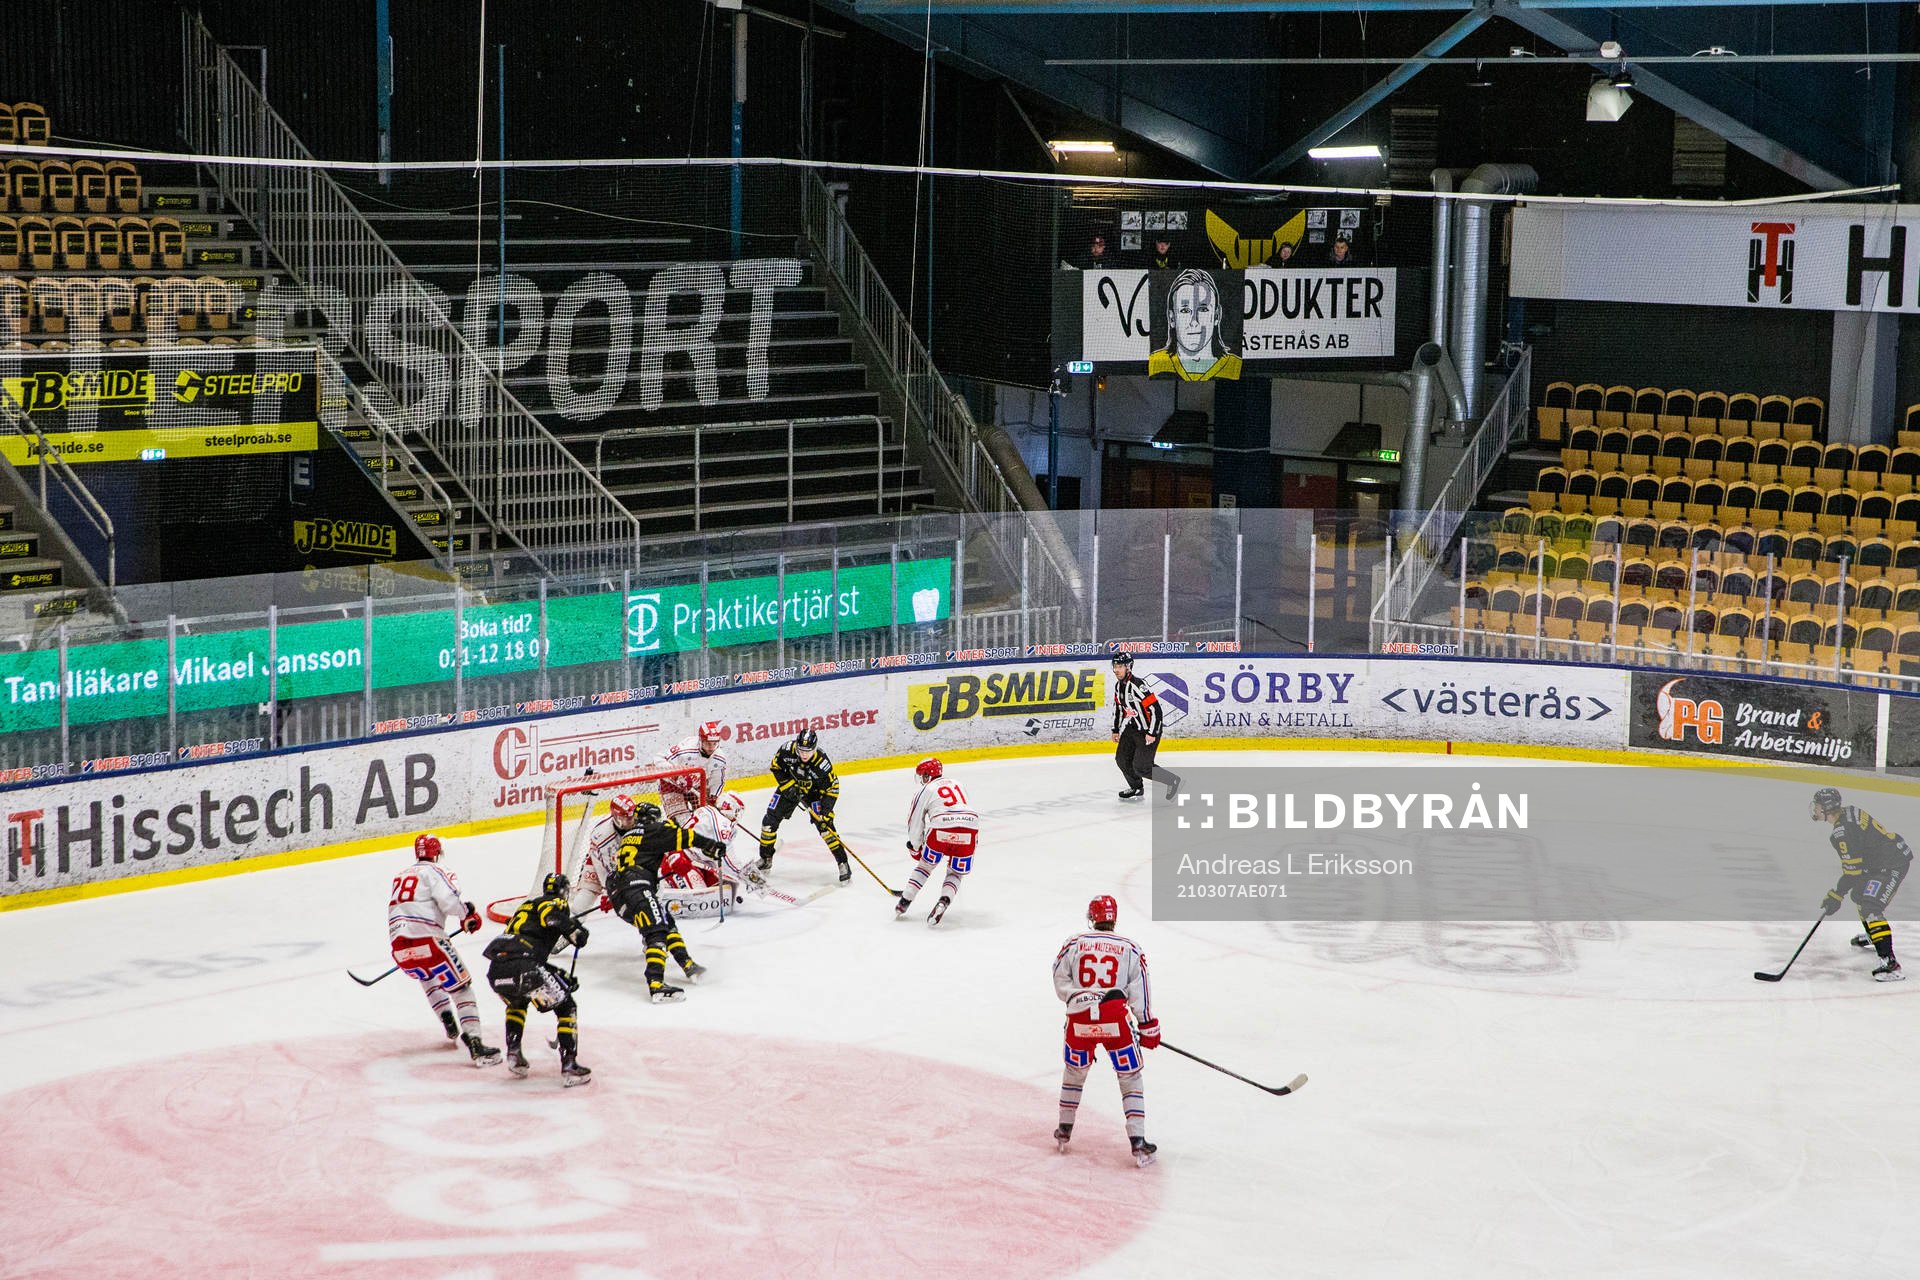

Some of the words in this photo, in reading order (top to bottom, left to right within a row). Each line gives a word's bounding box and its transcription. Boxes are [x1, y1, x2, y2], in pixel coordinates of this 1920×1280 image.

[1244, 277, 1384, 320] ODUKTER
[1242, 330, 1320, 350] STERÅS
[1325, 334, 1349, 349] AB
[204, 373, 302, 395] STEELPRO
[27, 442, 104, 458] jmide.se
[205, 431, 292, 448] steelproab.se
[460, 618, 498, 641] Boka
[501, 613, 533, 637] tid?
[504, 640, 525, 661] 18
[956, 647, 1018, 660] INTERSPORT
[1036, 642, 1101, 655] INTERSPORT
[1120, 641, 1188, 653] INTERSPORT
[172, 652, 254, 687] Mikael
[810, 659, 863, 674] INTERSPORT
[880, 652, 938, 668] INTERSPORT
[673, 676, 727, 693] INTERSPORT
[743, 667, 795, 683] INTERSPORT
[1204, 664, 1354, 704] SÖRBY
[526, 696, 584, 712] INTERSPORT
[601, 685, 656, 704] INTERSPORT
[375, 714, 440, 733] INTERSPORT
[461, 705, 510, 722] ERSPORT
[1043, 717, 1095, 729] STEELPRO
[1203, 709, 1250, 727] JÄRN
[1258, 712, 1271, 727] &
[1276, 712, 1353, 727] METALL
[1735, 702, 1801, 728] Brand
[1807, 710, 1822, 731] &
[736, 708, 879, 743] Raumaster
[191, 738, 262, 759] INTERSPORT
[1733, 729, 1853, 763] Arbetsmiljö
[95, 752, 170, 772] INTERSPORT
[539, 745, 636, 774] Carlhans
[0, 763, 67, 782] NTERSPOR
[937, 784, 967, 807] 91
[58, 765, 333, 874] Hisstech
[355, 753, 439, 825] AB
[688, 898, 730, 912] COOR
[1078, 953, 1119, 988] 63
